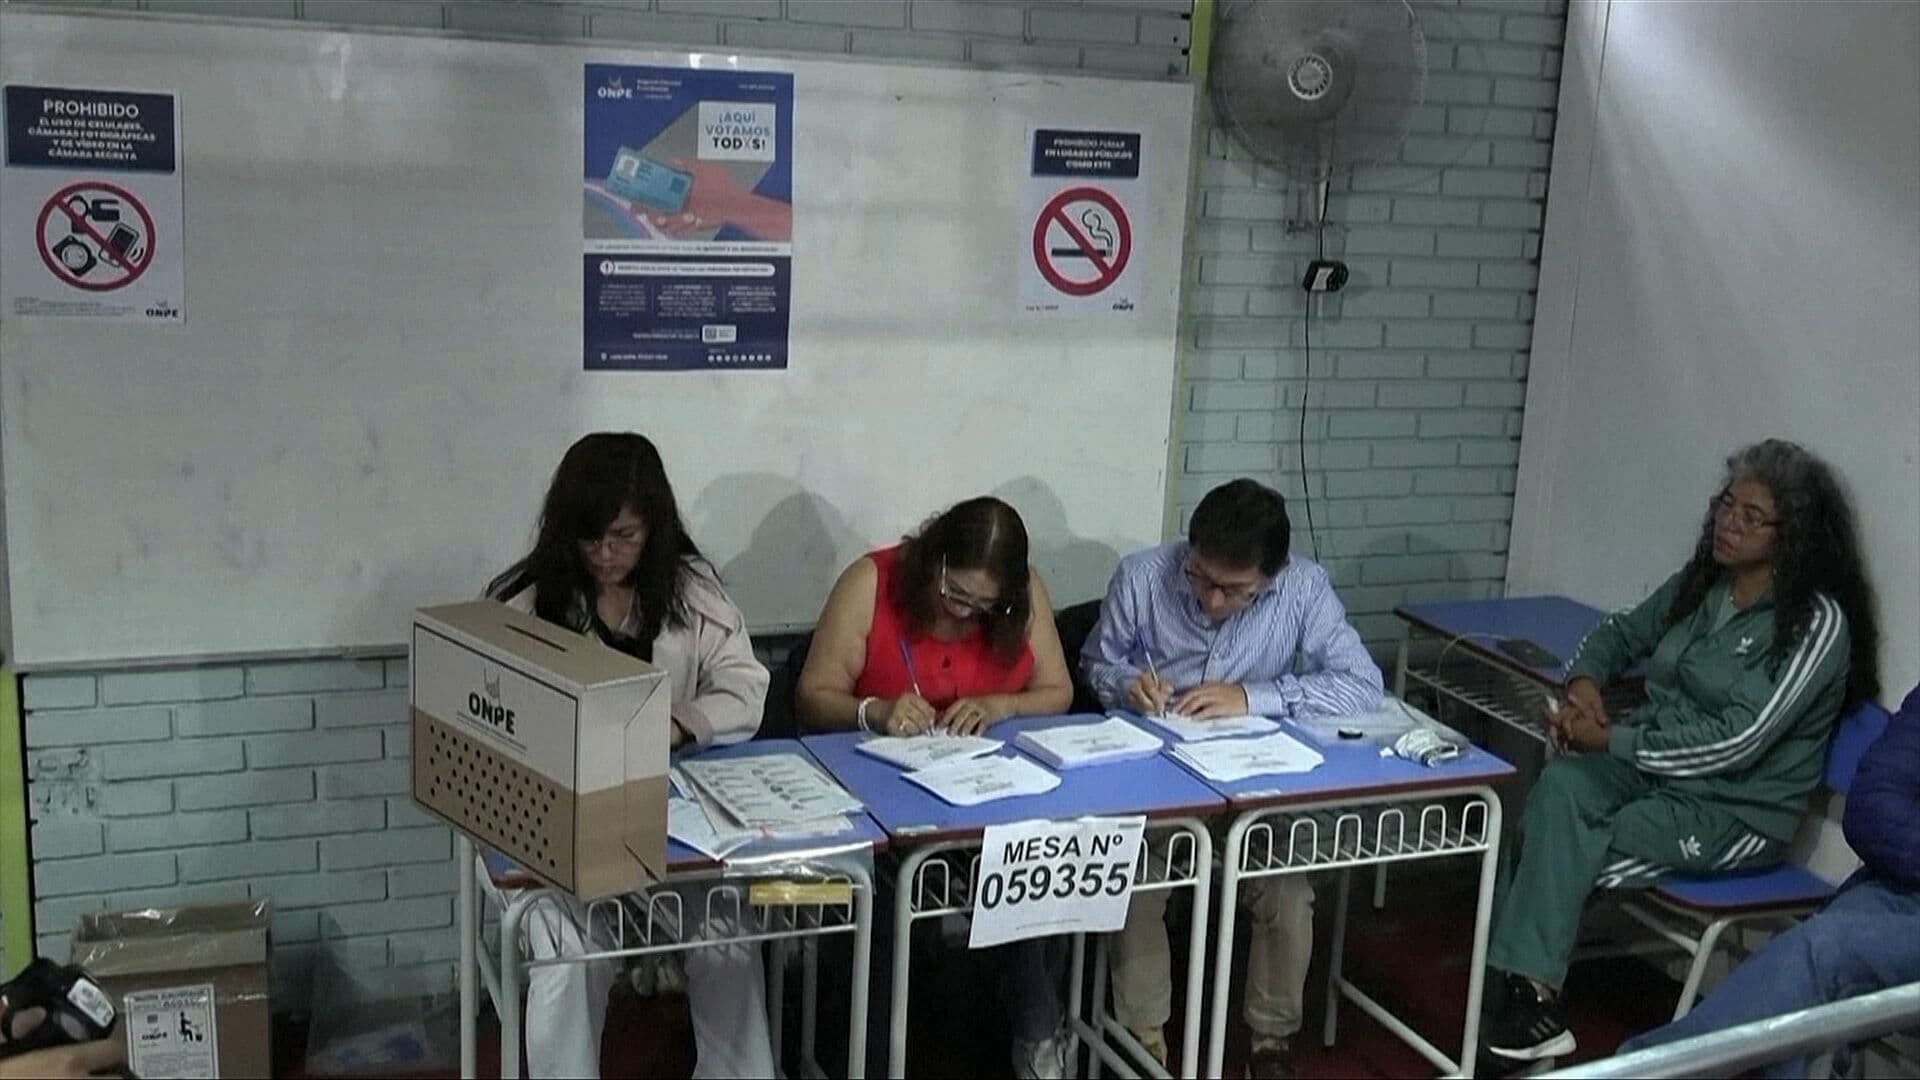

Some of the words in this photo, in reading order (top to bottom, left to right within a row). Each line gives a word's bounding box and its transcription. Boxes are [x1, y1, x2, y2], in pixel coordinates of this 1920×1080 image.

[598, 87, 632, 99] ONPE
[43, 98, 139, 118] PROHIBIDO
[51, 118, 72, 127] USO
[74, 119, 86, 127] DE
[705, 125, 770, 136] VOTAMOS
[146, 308, 178, 318] ONPE
[468, 691, 516, 735] ONPE
[1003, 835, 1081, 865] MESA
[981, 862, 1130, 909] 059355
